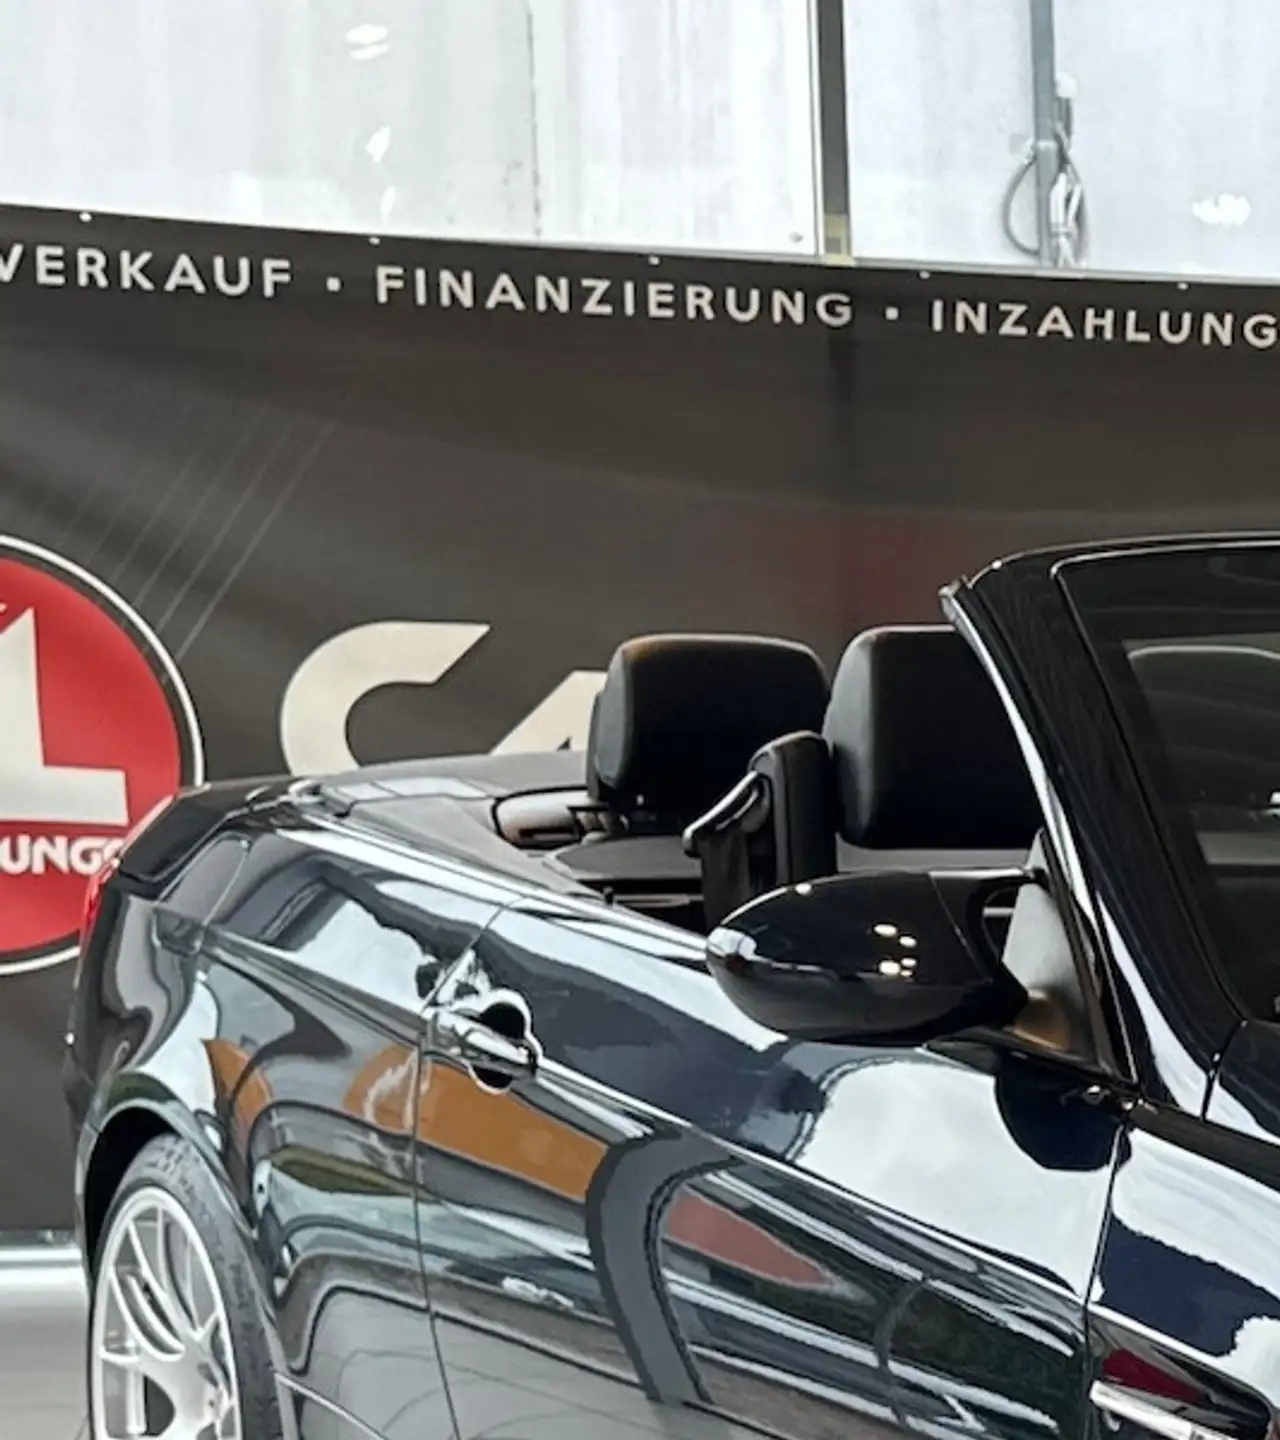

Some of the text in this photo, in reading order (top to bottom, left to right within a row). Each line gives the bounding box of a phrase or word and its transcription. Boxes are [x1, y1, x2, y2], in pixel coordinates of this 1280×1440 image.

[0, 243, 291, 298] VERKAUF
[375, 265, 854, 327] FINANZIERUNG
[931, 299, 1278, 349] INZAHLUNG
